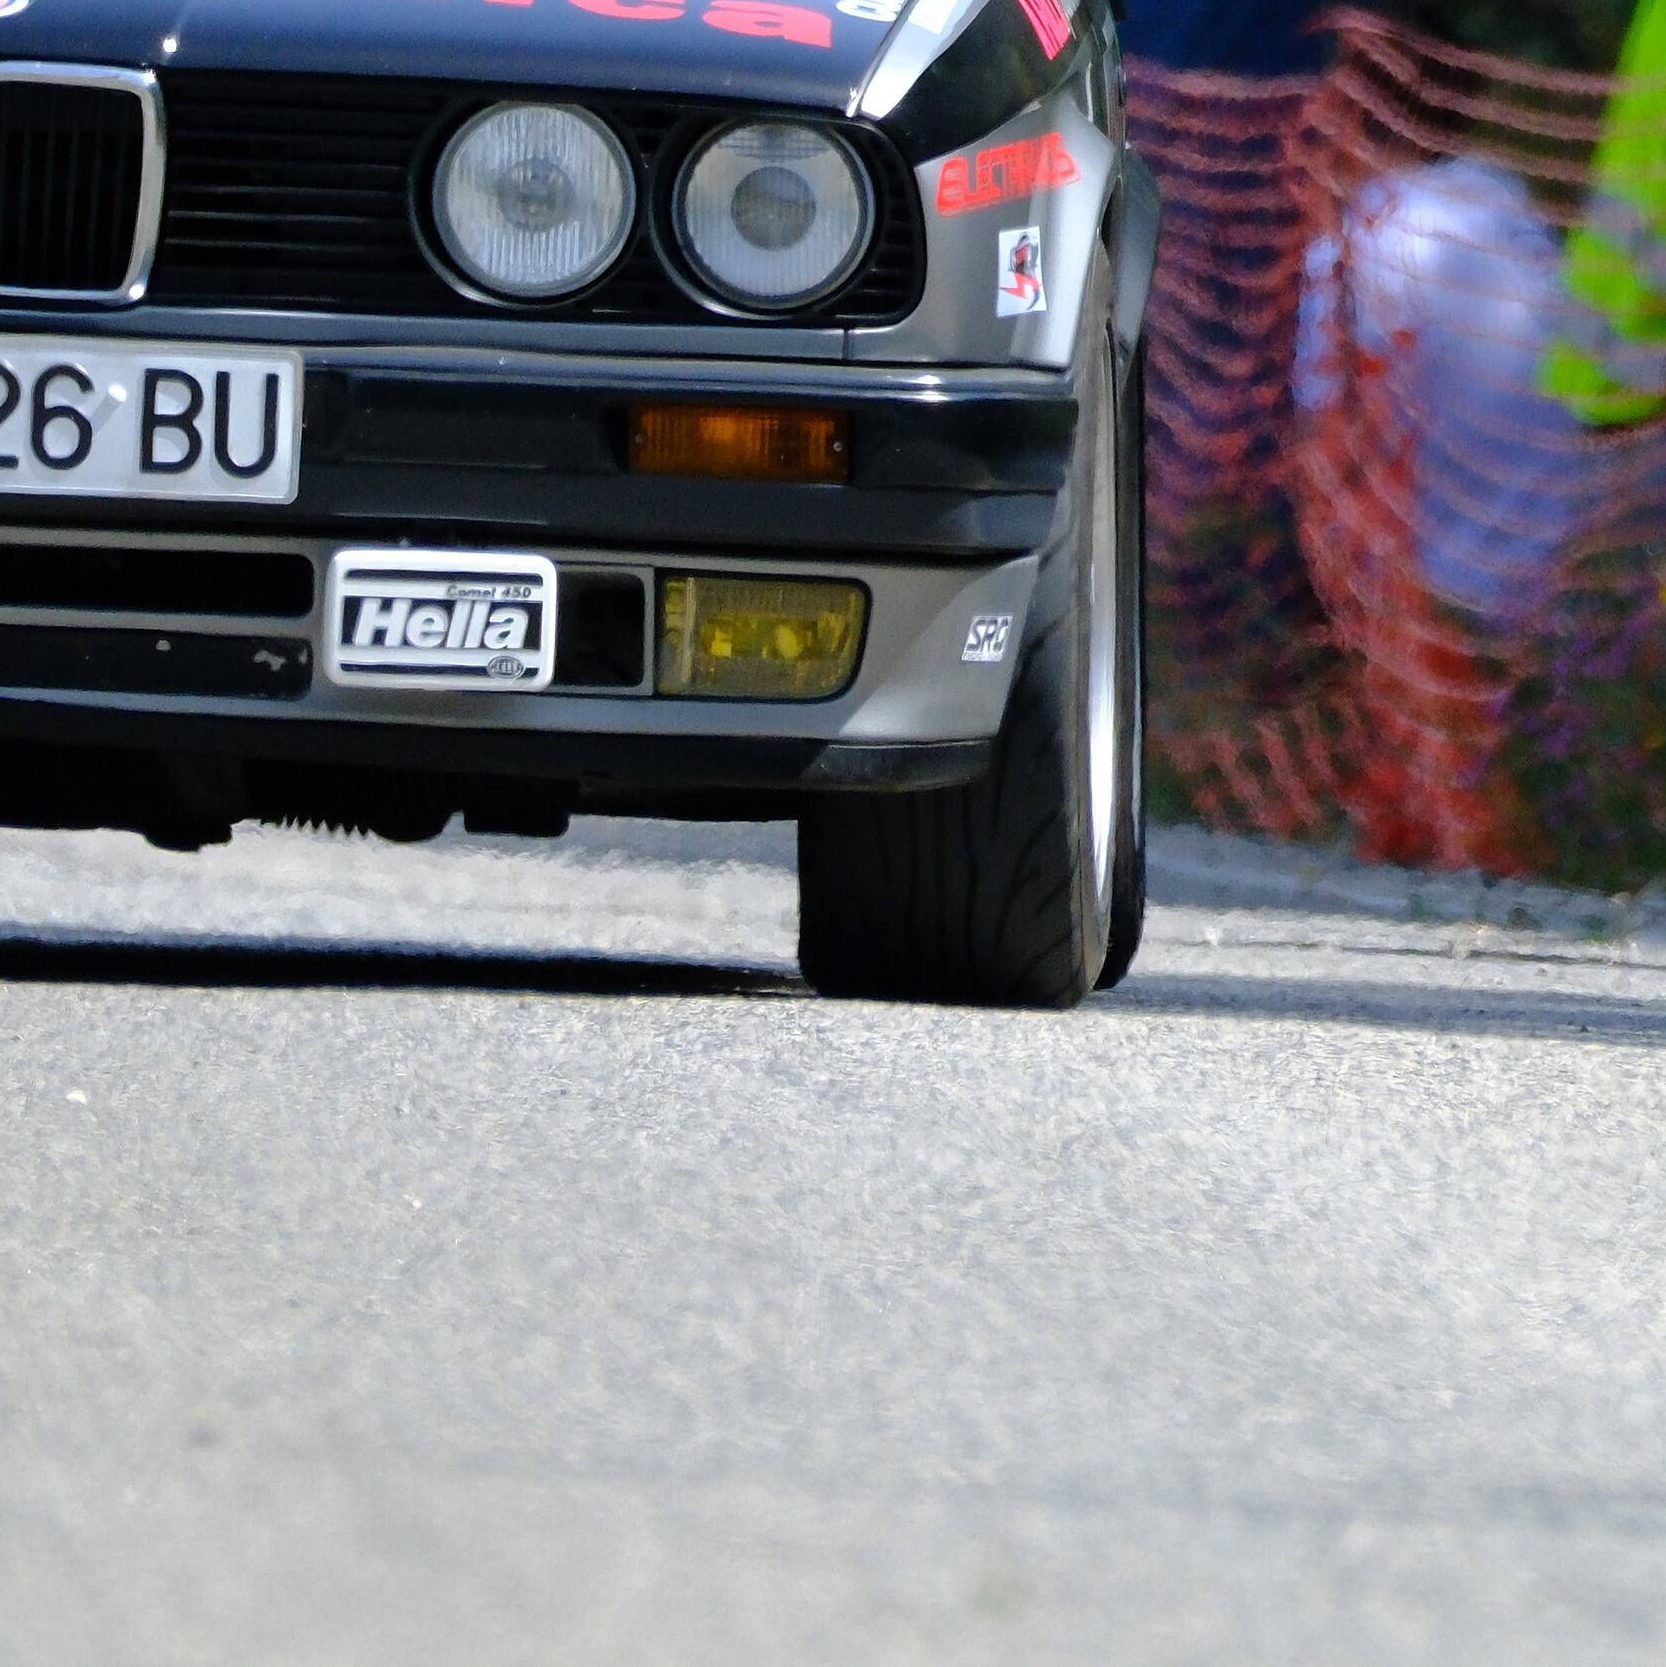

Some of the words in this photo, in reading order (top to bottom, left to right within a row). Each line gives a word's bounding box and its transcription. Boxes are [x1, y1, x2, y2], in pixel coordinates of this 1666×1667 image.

[138, 367, 280, 478] BU
[501, 585, 532, 599] 450
[354, 597, 530, 650] Hella
